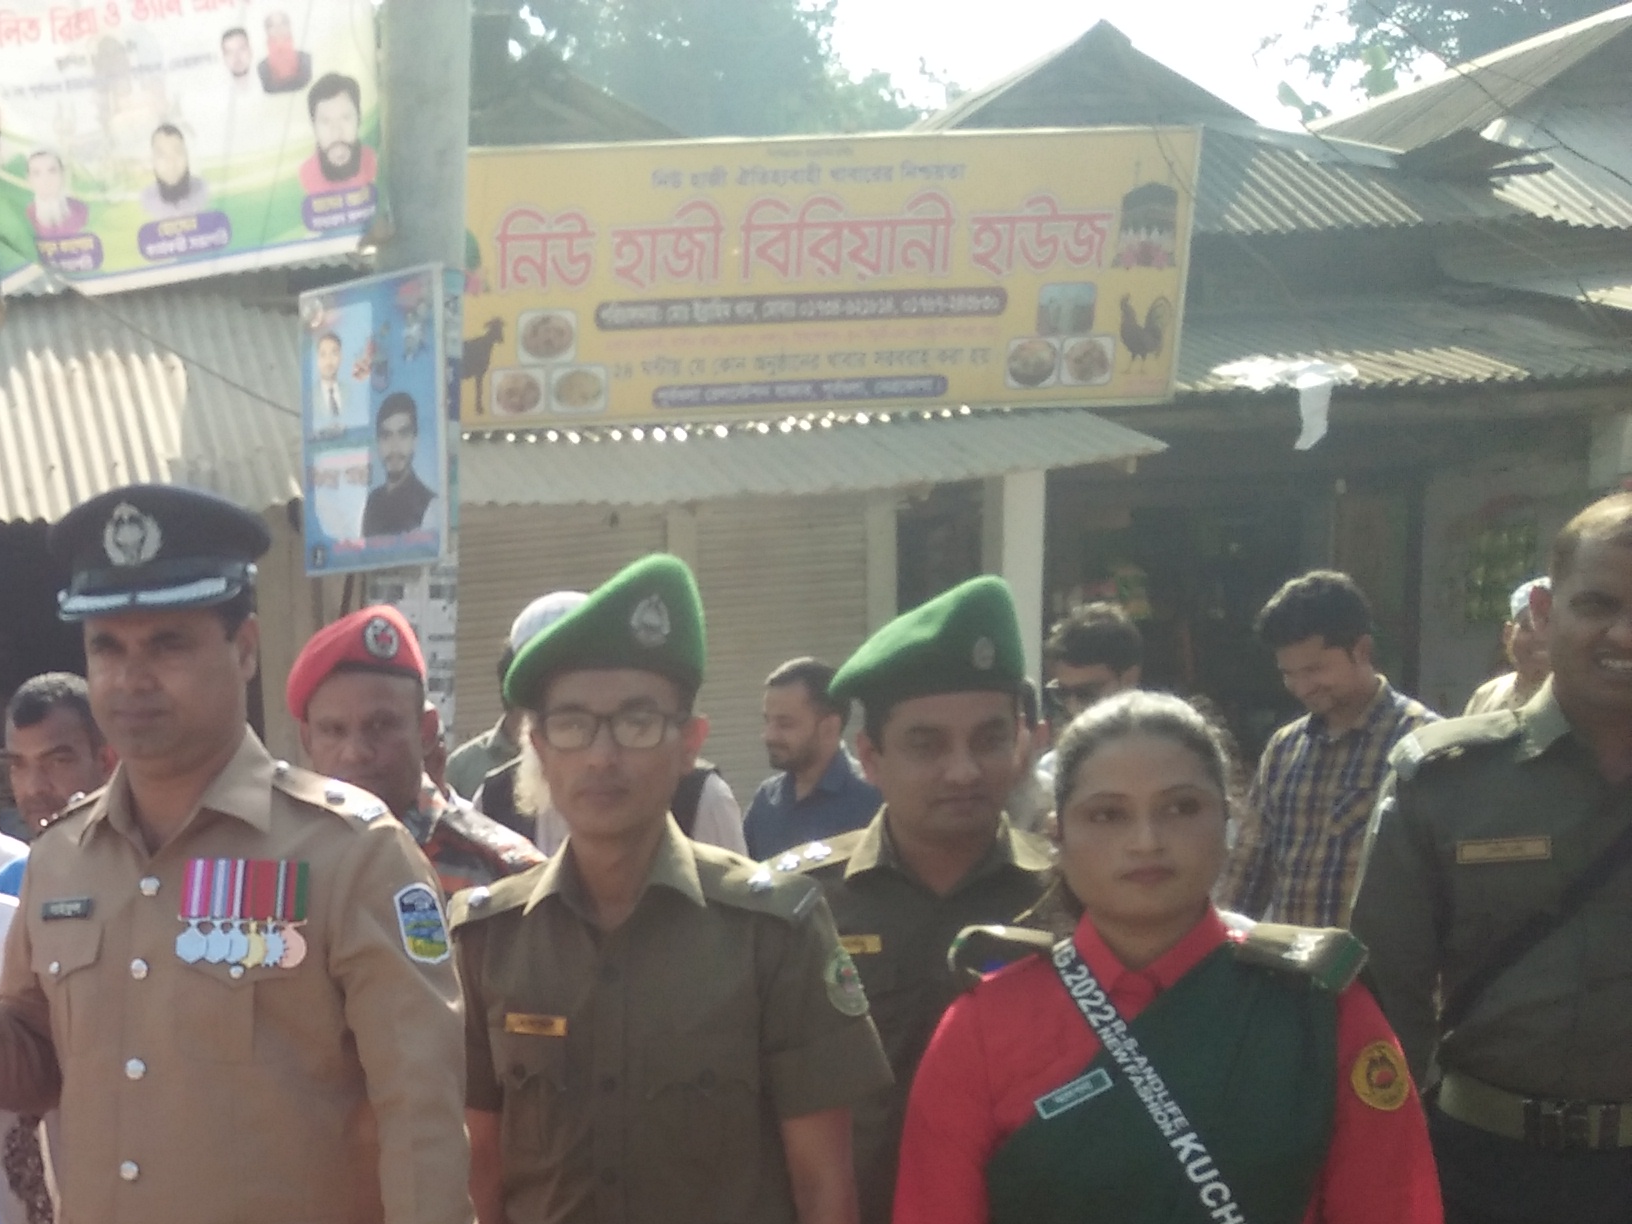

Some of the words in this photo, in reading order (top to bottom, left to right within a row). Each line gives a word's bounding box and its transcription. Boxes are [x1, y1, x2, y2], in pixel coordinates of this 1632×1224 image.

[496, 206, 595, 291] নিউ
[612, 200, 724, 289] হাজী
[741, 192, 954, 281] বিরিয়ানী
[970, 197, 1116, 277] হাউজ
